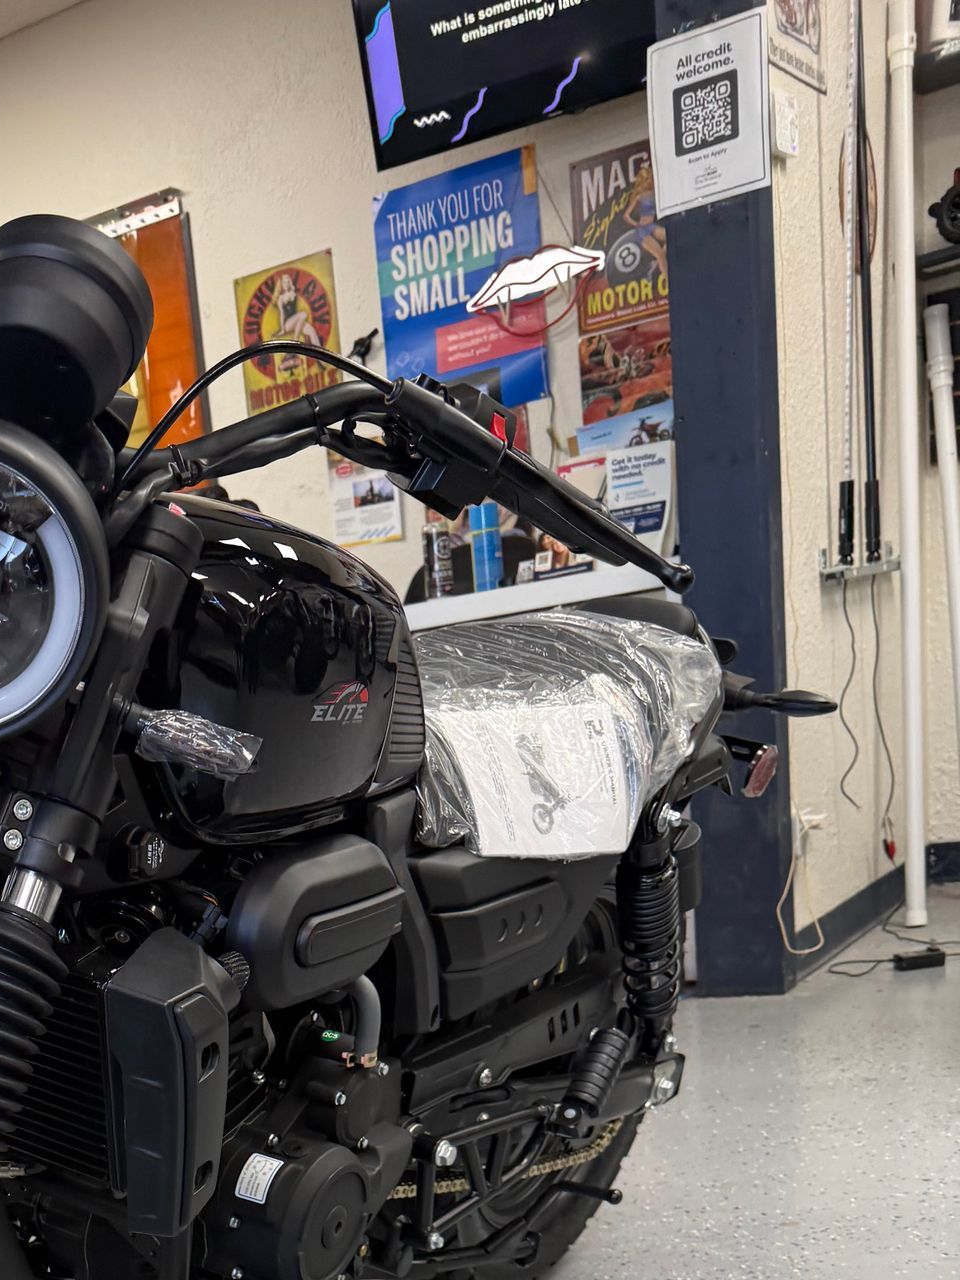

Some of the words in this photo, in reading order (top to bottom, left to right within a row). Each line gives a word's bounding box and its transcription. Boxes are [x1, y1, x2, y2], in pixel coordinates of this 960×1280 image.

[430, 15, 462, 37] What
[463, 12, 476, 25] is
[461, 2, 555, 43] embarrassingly
[675, 56, 734, 82] welcome.
[676, 54, 692, 70] All
[694, 42, 733, 64] credit
[387, 200, 438, 242] THANK
[437, 189, 469, 225] YOU
[472, 179, 504, 215] FOR
[391, 211, 514, 282] SHOPPING
[393, 267, 471, 321] SMALL
[587, 278, 653, 316] MOTOR
[250, 379, 302, 411] MOTOR
[612, 457, 625, 467] Get
[626, 456, 633, 464] it
[634, 453, 657, 463] today
[612, 465, 630, 474] with
[631, 463, 642, 471] no
[642, 458, 666, 469] credit
[612, 470, 643, 481] needed.
[310, 703, 368, 722] ELITE
